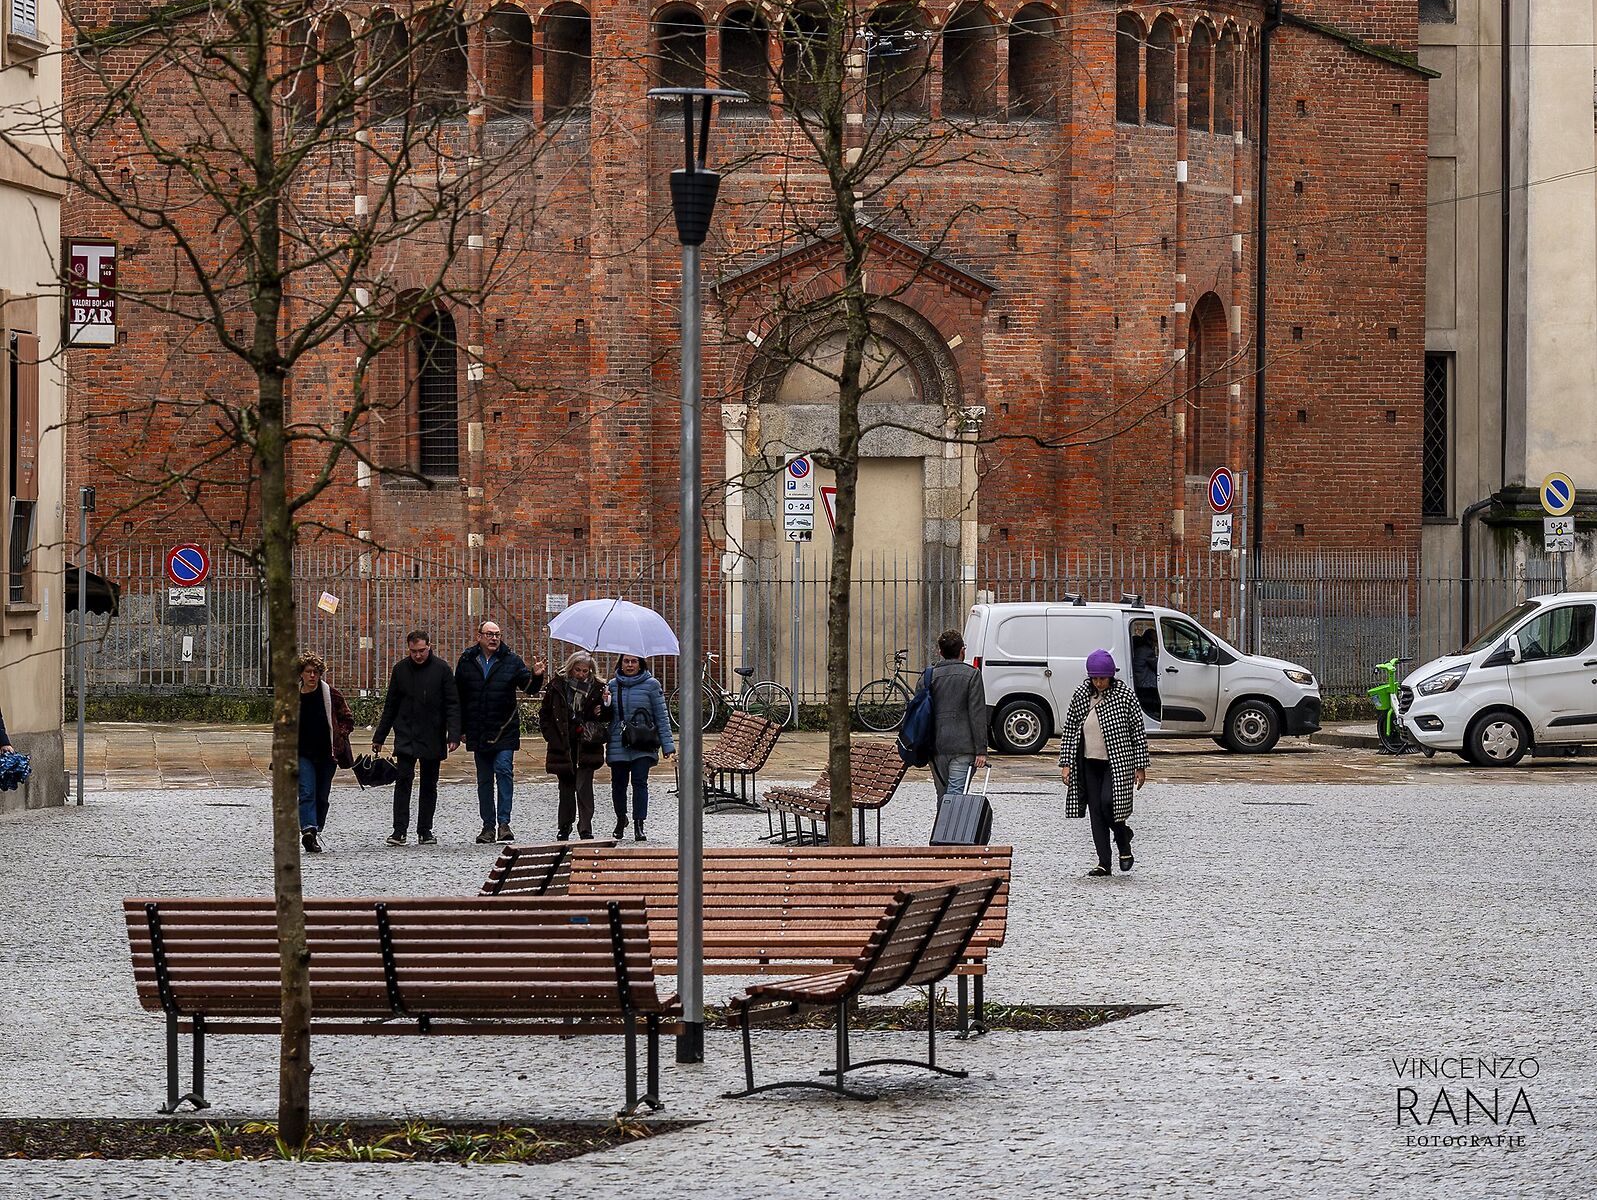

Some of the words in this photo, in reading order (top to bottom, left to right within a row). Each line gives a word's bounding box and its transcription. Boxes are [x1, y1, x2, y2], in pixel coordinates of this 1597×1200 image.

[72, 245, 115, 297] T
[72, 299, 91, 307] VALORI
[74, 308, 112, 323] BAR
